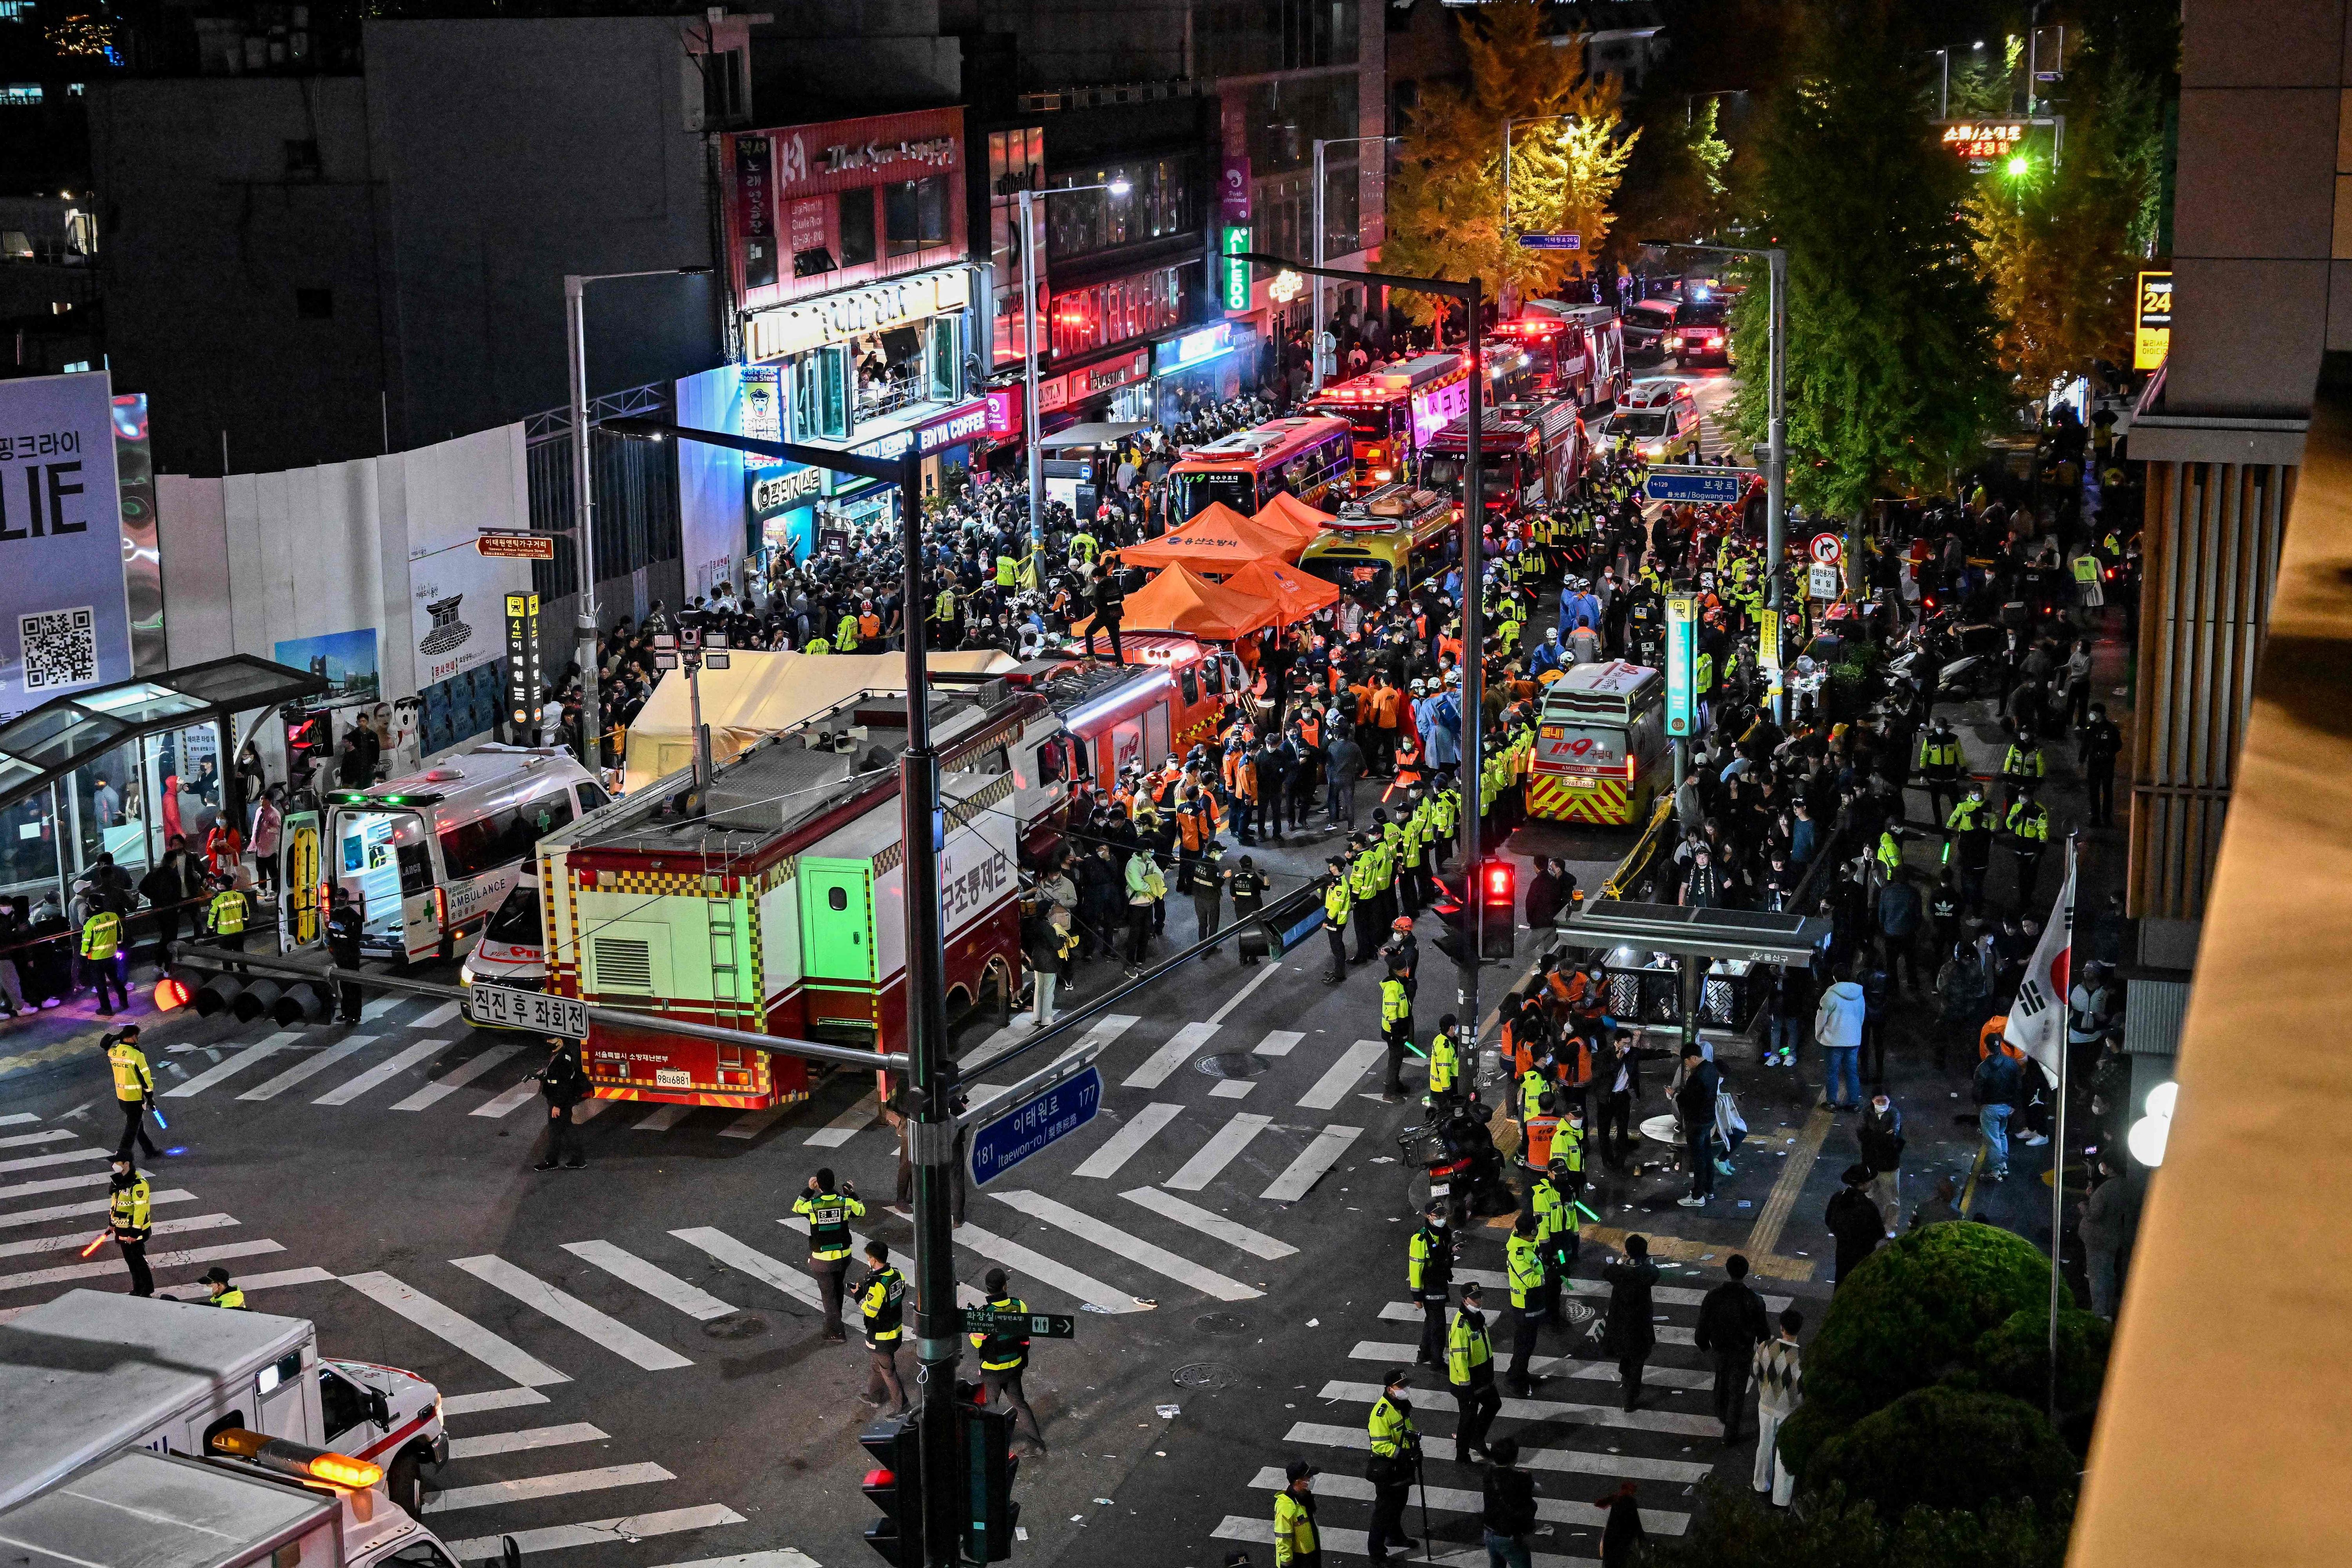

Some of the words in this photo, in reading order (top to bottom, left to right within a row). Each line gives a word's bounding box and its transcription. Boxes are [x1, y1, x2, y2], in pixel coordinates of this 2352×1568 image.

[1230, 229, 1244, 309] ALPEDO
[2143, 292, 2171, 313] 24
[920, 424, 949, 450] EDIYA
[949, 410, 985, 439] COFFEE
[0, 430, 80, 461] 핑크라이
[1183, 473, 1206, 483] 119
[1703, 480, 1734, 491] 보광로
[1691, 491, 1734, 501] Bogwang-ro
[485, 538, 546, 549] 이태원앤틱가구거리
[1184, 538, 1238, 547] 용산소방서
[1811, 567, 1835, 578] 보행전용거리
[512, 620, 521, 631] 4
[435, 660, 455, 677] 공사안내
[1118, 731, 1139, 766] 119
[1548, 738, 1593, 758] 119
[1590, 750, 1613, 760] 구급대
[1561, 765, 1597, 773] AMBULANCE
[944, 856, 952, 874] 시
[942, 848, 1007, 923] 구조통제단
[223, 894, 238, 902] 경찰
[450, 878, 506, 910] AMBULANCE
[95, 915, 110, 924] 경찰
[1764, 953, 1788, 963] 용산구
[475, 989, 507, 1020] 직진
[513, 994, 528, 1024] 후
[535, 1000, 584, 1035] 좌회전
[595, 1050, 627, 1060] 서울특별시
[629, 1053, 669, 1063] 소방재난본부
[657, 1074, 689, 1085] 98더6881
[1079, 1084, 1095, 1108] 177
[1014, 1095, 1059, 1134] 이태원로
[976, 1143, 993, 1168] 181
[998, 1133, 1042, 1169] Itaewon-ro
[891, 1282, 900, 1293] 경찰
[966, 1311, 994, 1321] 화장실
